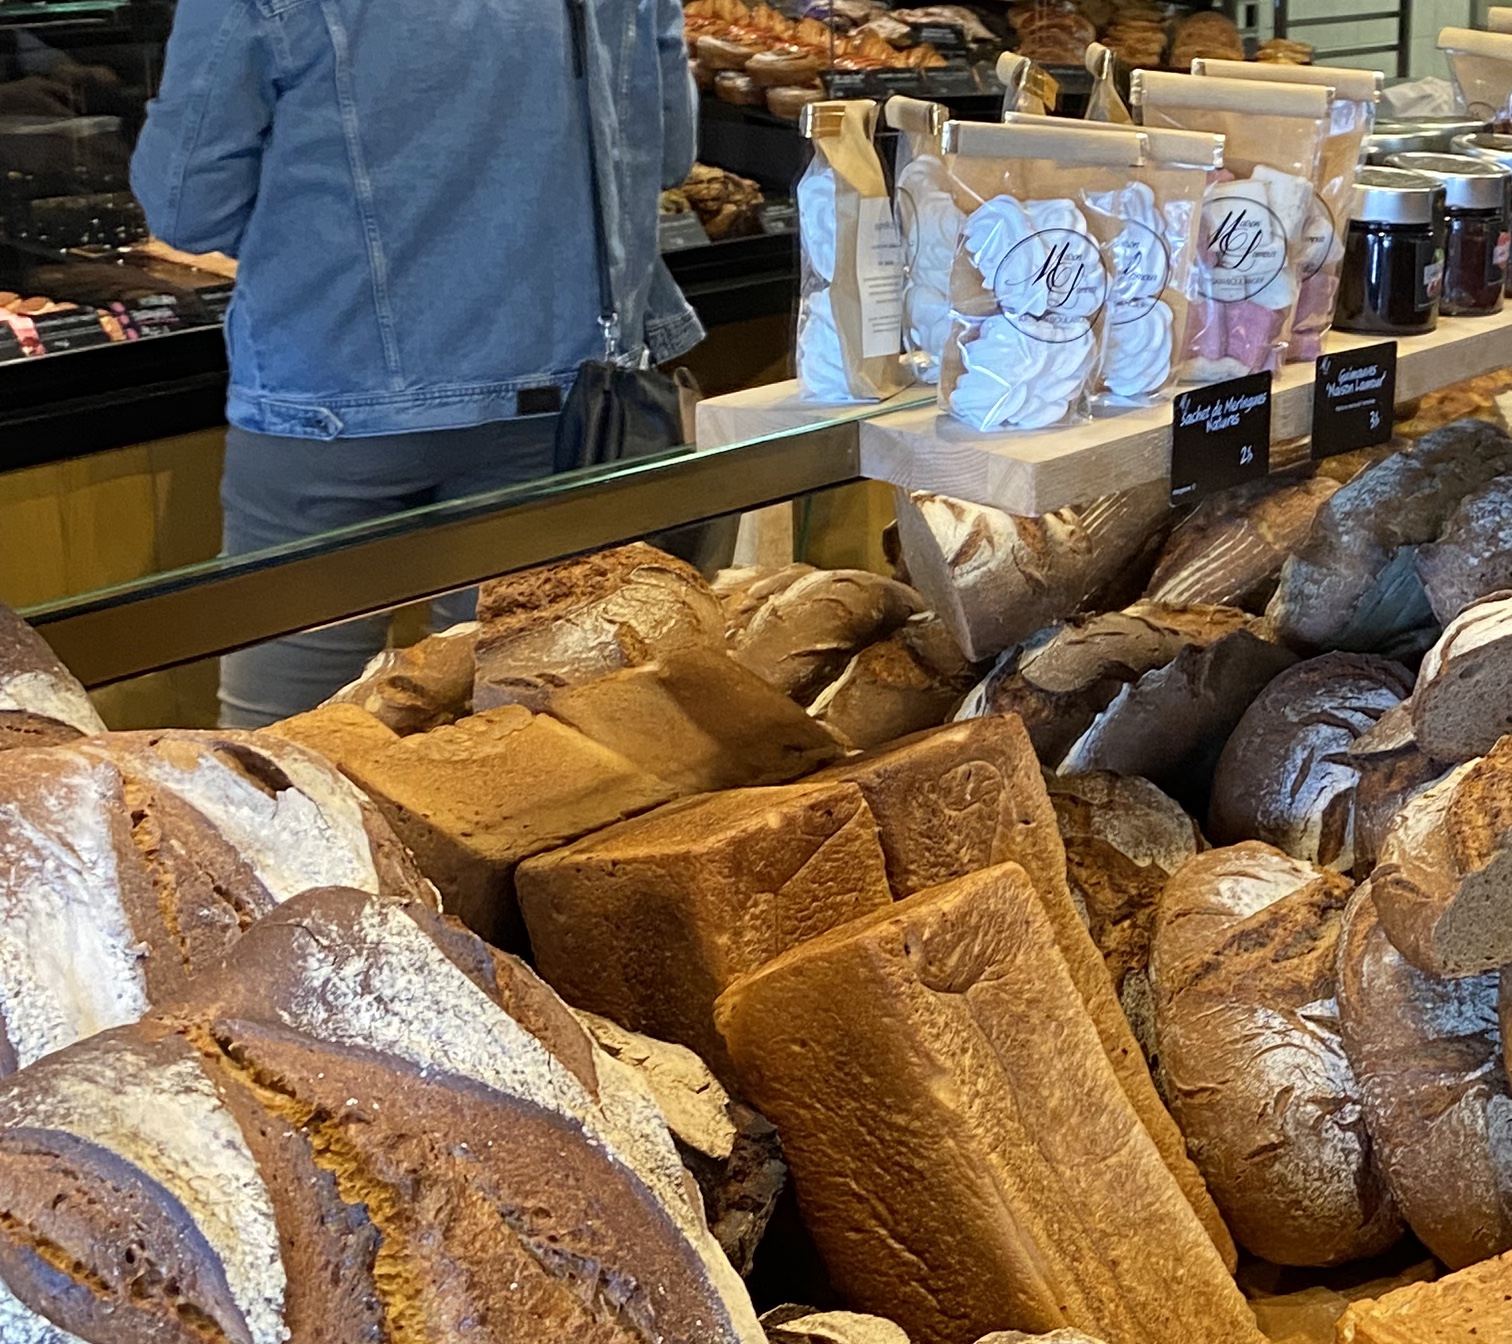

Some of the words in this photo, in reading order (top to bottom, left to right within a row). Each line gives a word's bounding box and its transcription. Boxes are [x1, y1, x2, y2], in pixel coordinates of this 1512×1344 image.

[1180, 404, 1211, 427] Sachet
[1210, 399, 1223, 420] de
[1223, 392, 1267, 414] Meringues
